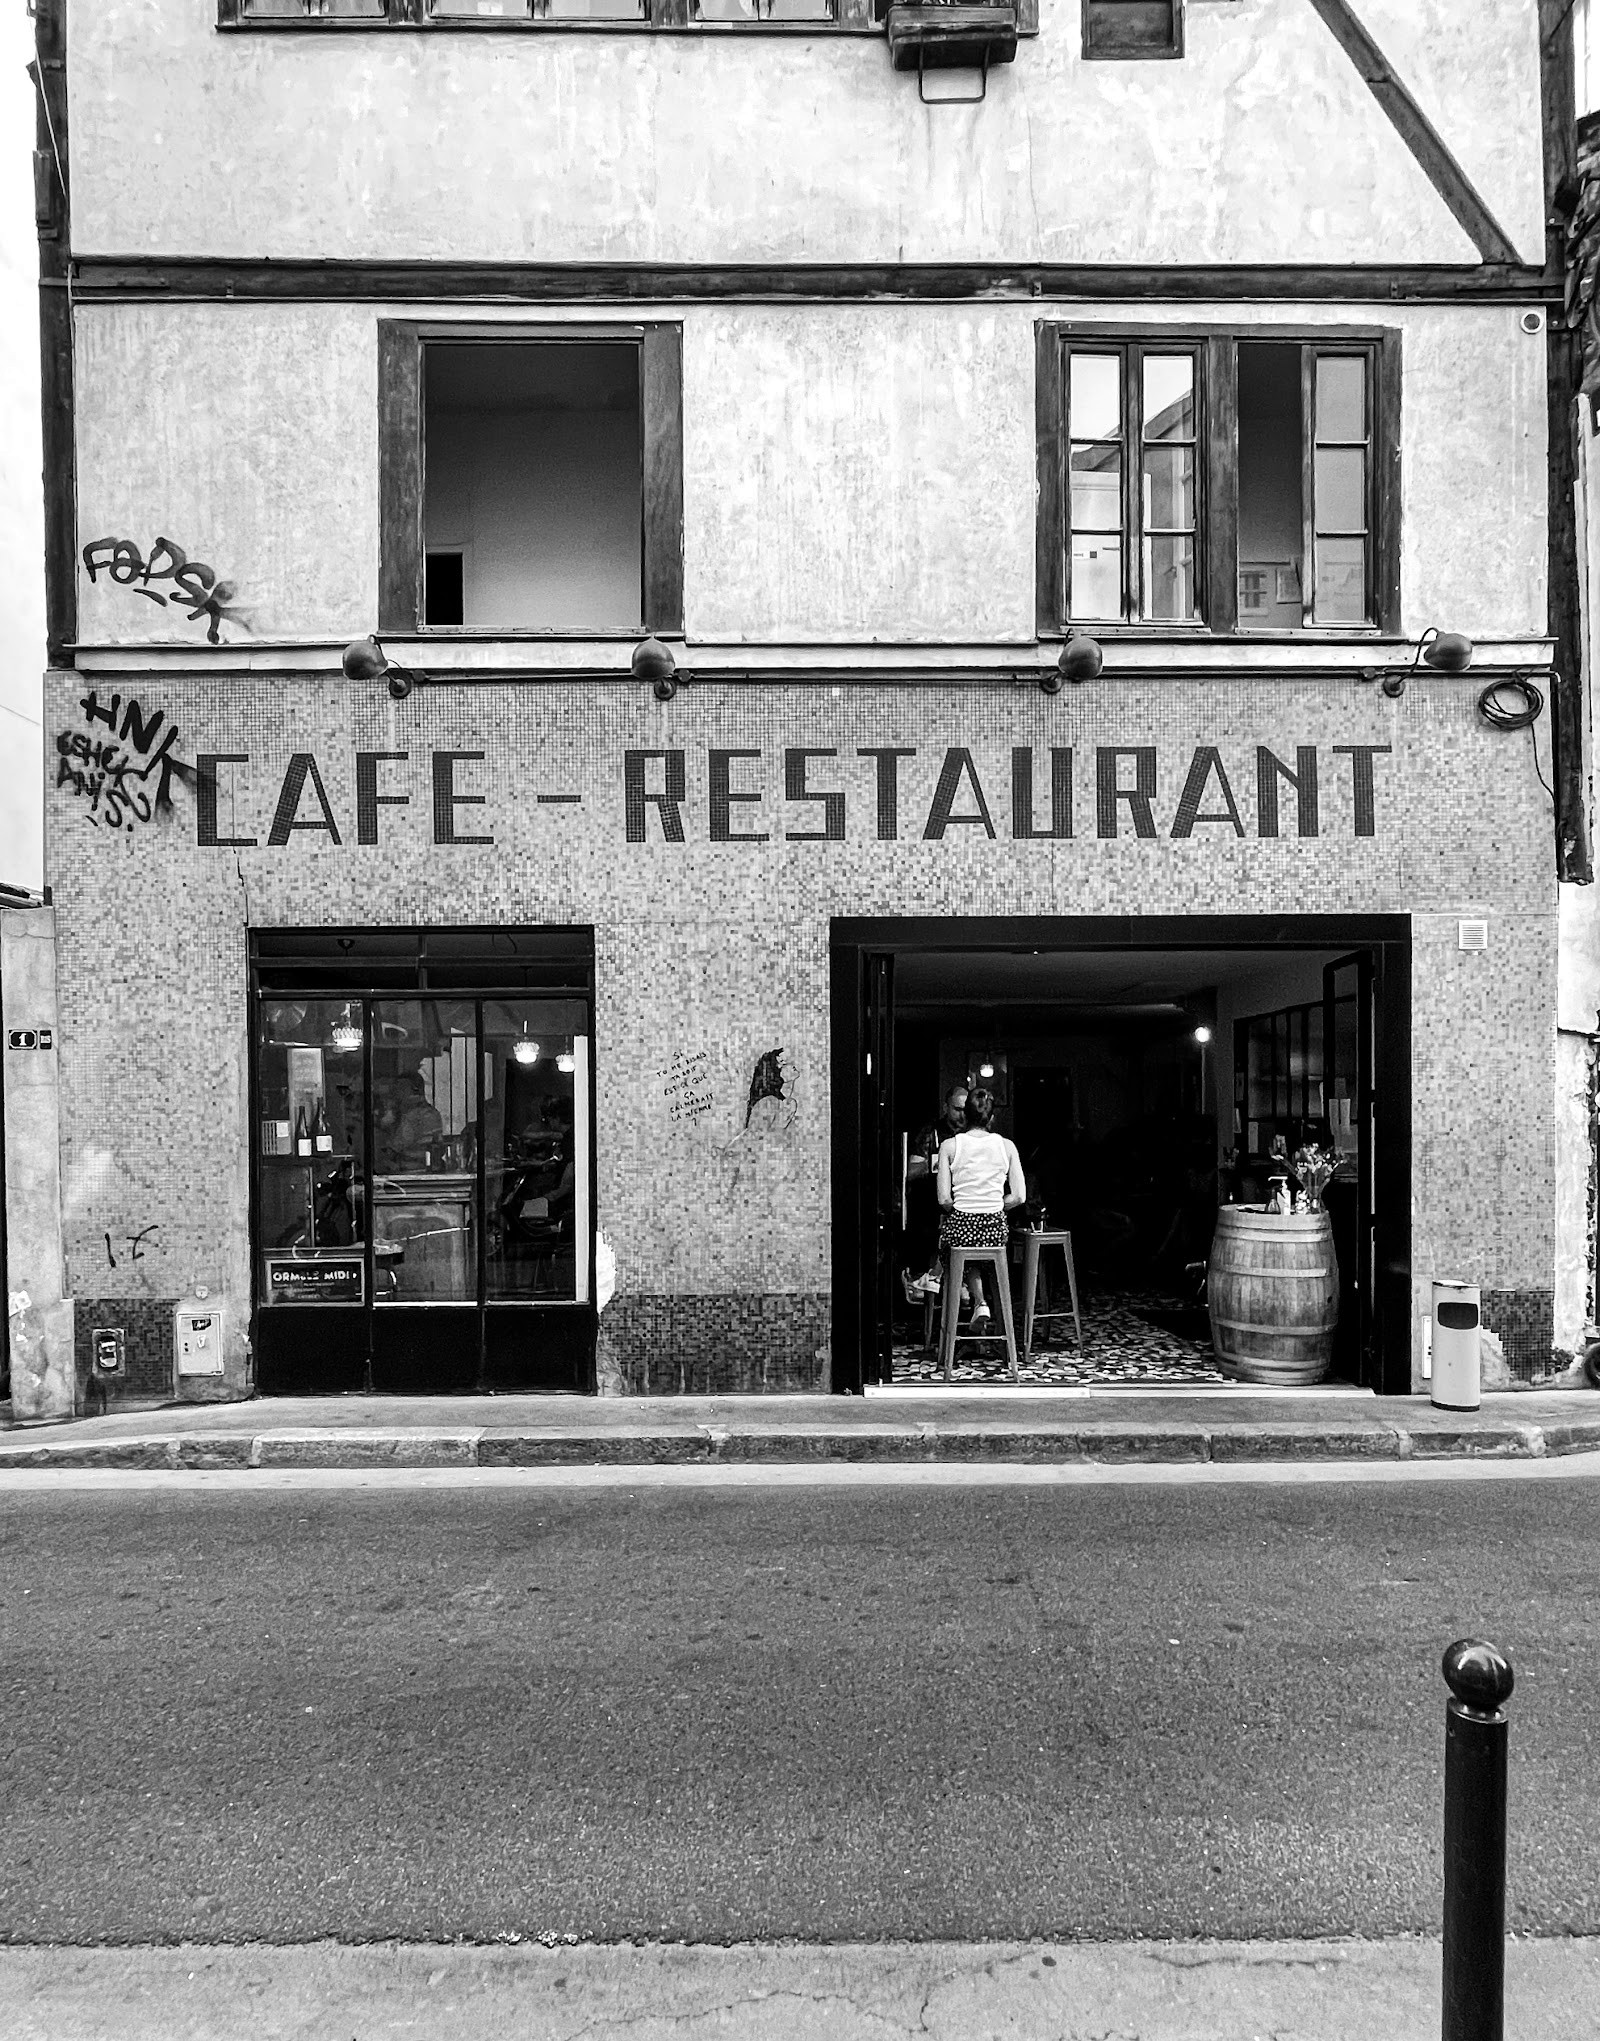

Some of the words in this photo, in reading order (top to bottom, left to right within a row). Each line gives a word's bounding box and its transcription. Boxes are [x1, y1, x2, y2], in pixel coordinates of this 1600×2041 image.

[196, 751, 495, 847] CAFE
[624, 745, 1392, 842] RESTAURANT
[19, 1033, 27, 1046] 1
[692, 1072, 708, 1084] QUE
[671, 1114, 682, 1122] LA
